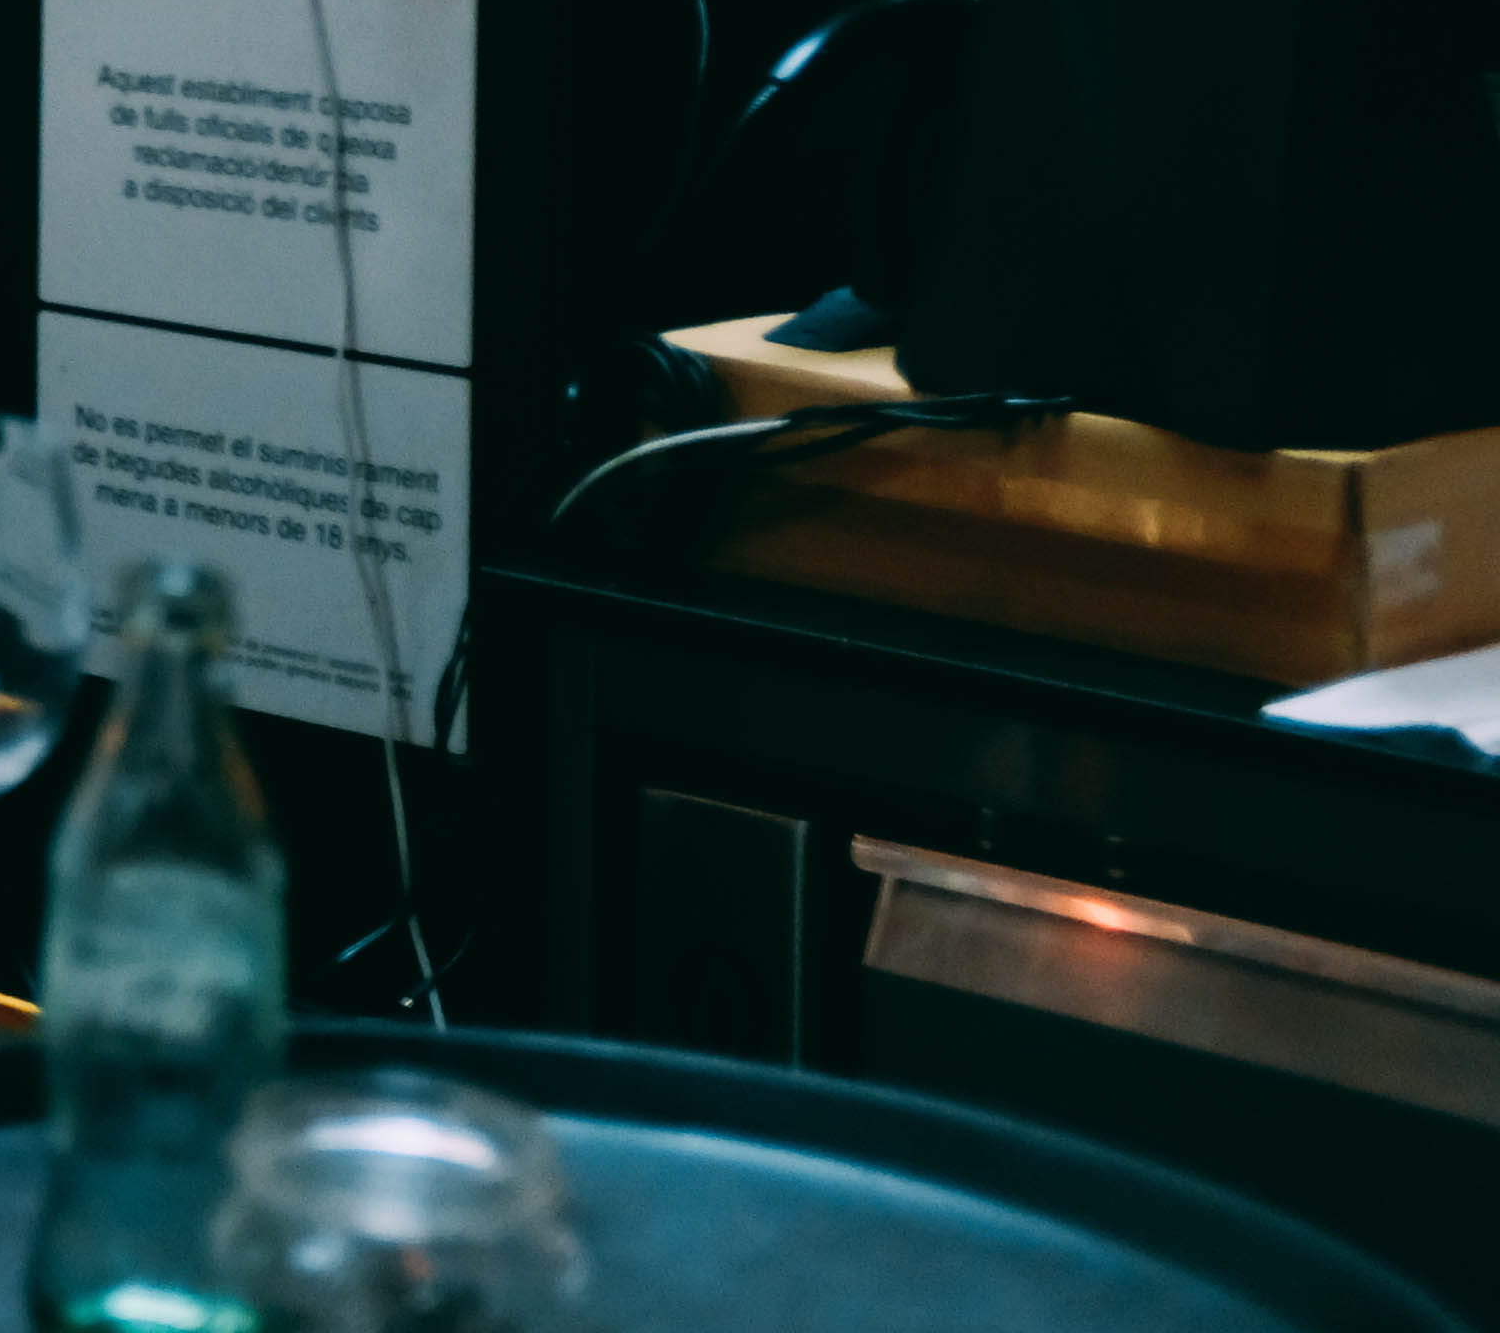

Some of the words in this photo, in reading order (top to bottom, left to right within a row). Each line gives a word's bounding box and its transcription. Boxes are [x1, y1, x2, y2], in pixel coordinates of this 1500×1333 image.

[98, 64, 176, 96] Aquest
[181, 79, 313, 113] establiment
[109, 105, 139, 127] de
[195, 113, 274, 145] oficials
[280, 125, 309, 150] de
[122, 179, 139, 199] a
[143, 179, 256, 216] disposició
[74, 403, 108, 433] No
[112, 416, 139, 438] es
[144, 420, 226, 454] permet
[230, 434, 252, 459] el
[258, 442, 440, 493] suminisrament
[73, 440, 100, 466] de
[106, 446, 201, 485] begudes
[360, 496, 389, 521] de
[396, 505, 443, 535] cap
[96, 483, 158, 514] mena
[163, 496, 179, 517] a
[185, 500, 270, 535] menors
[276, 515, 306, 542] de
[314, 523, 344, 549] 18
